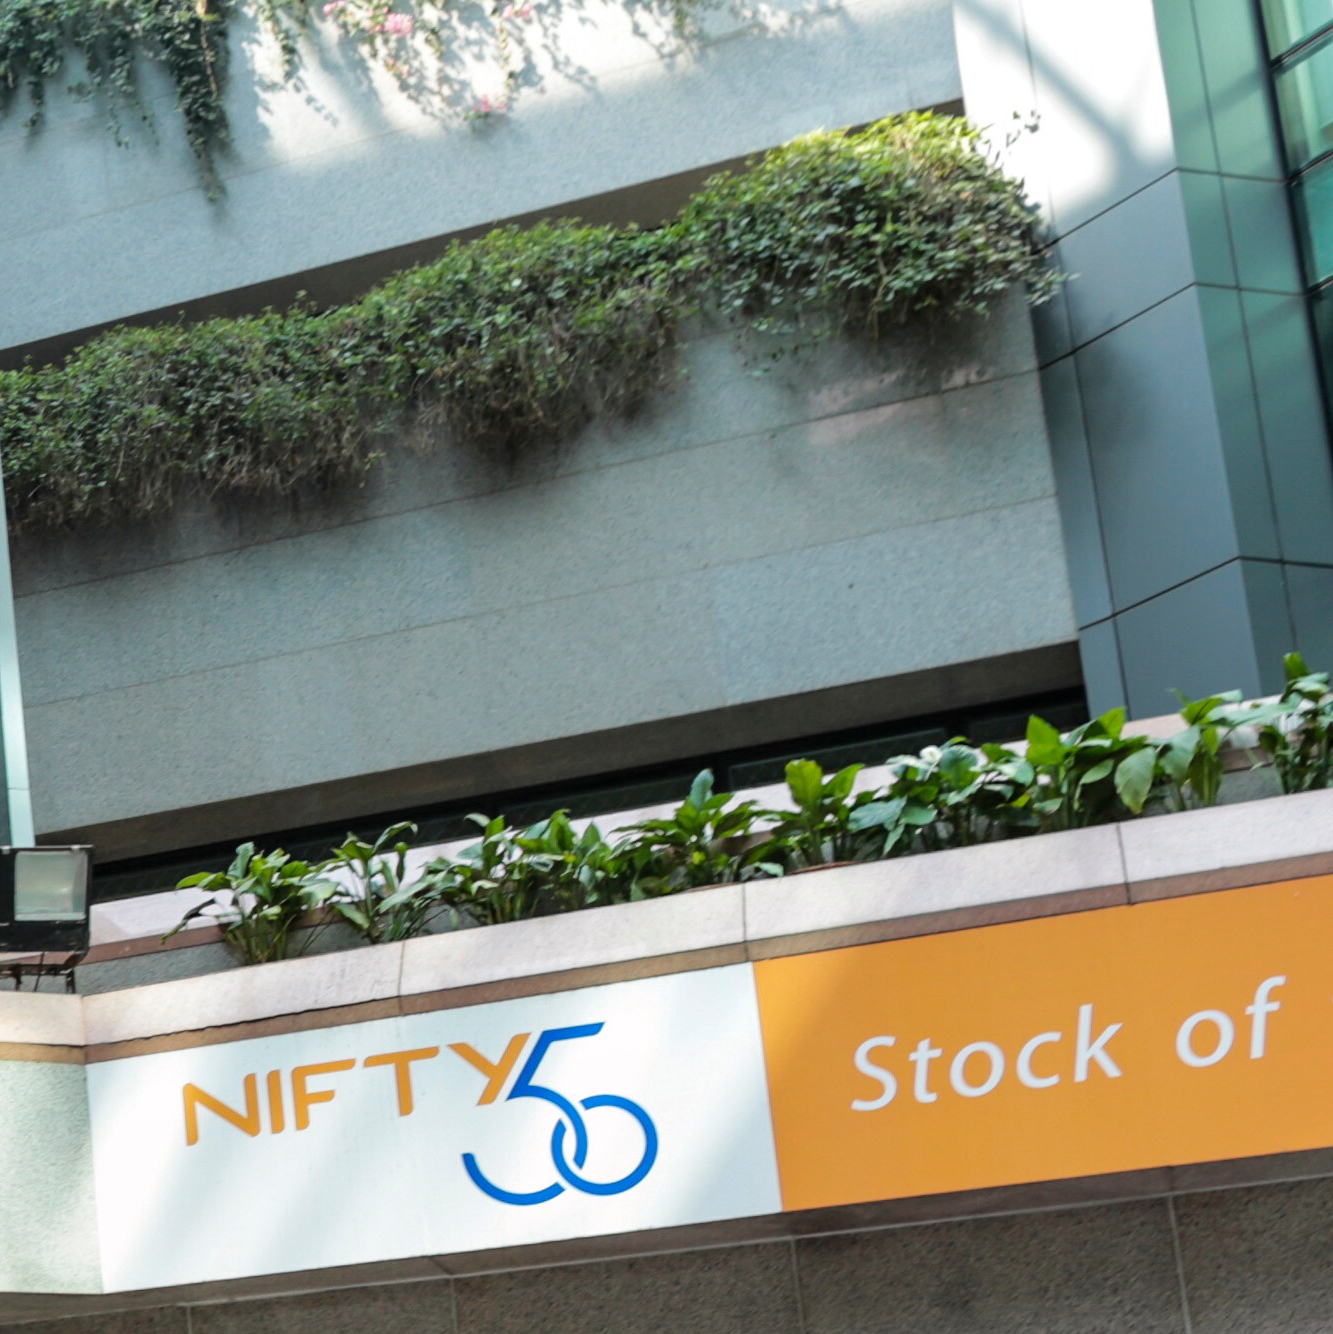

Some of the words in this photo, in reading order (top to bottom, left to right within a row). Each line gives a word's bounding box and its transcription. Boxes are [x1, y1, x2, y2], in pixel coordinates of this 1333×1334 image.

[182, 1032, 531, 1147] NIFTY
[462, 1021, 660, 1206] 50
[850, 1002, 1125, 1112] Stock
[1175, 975, 1288, 1068] of
